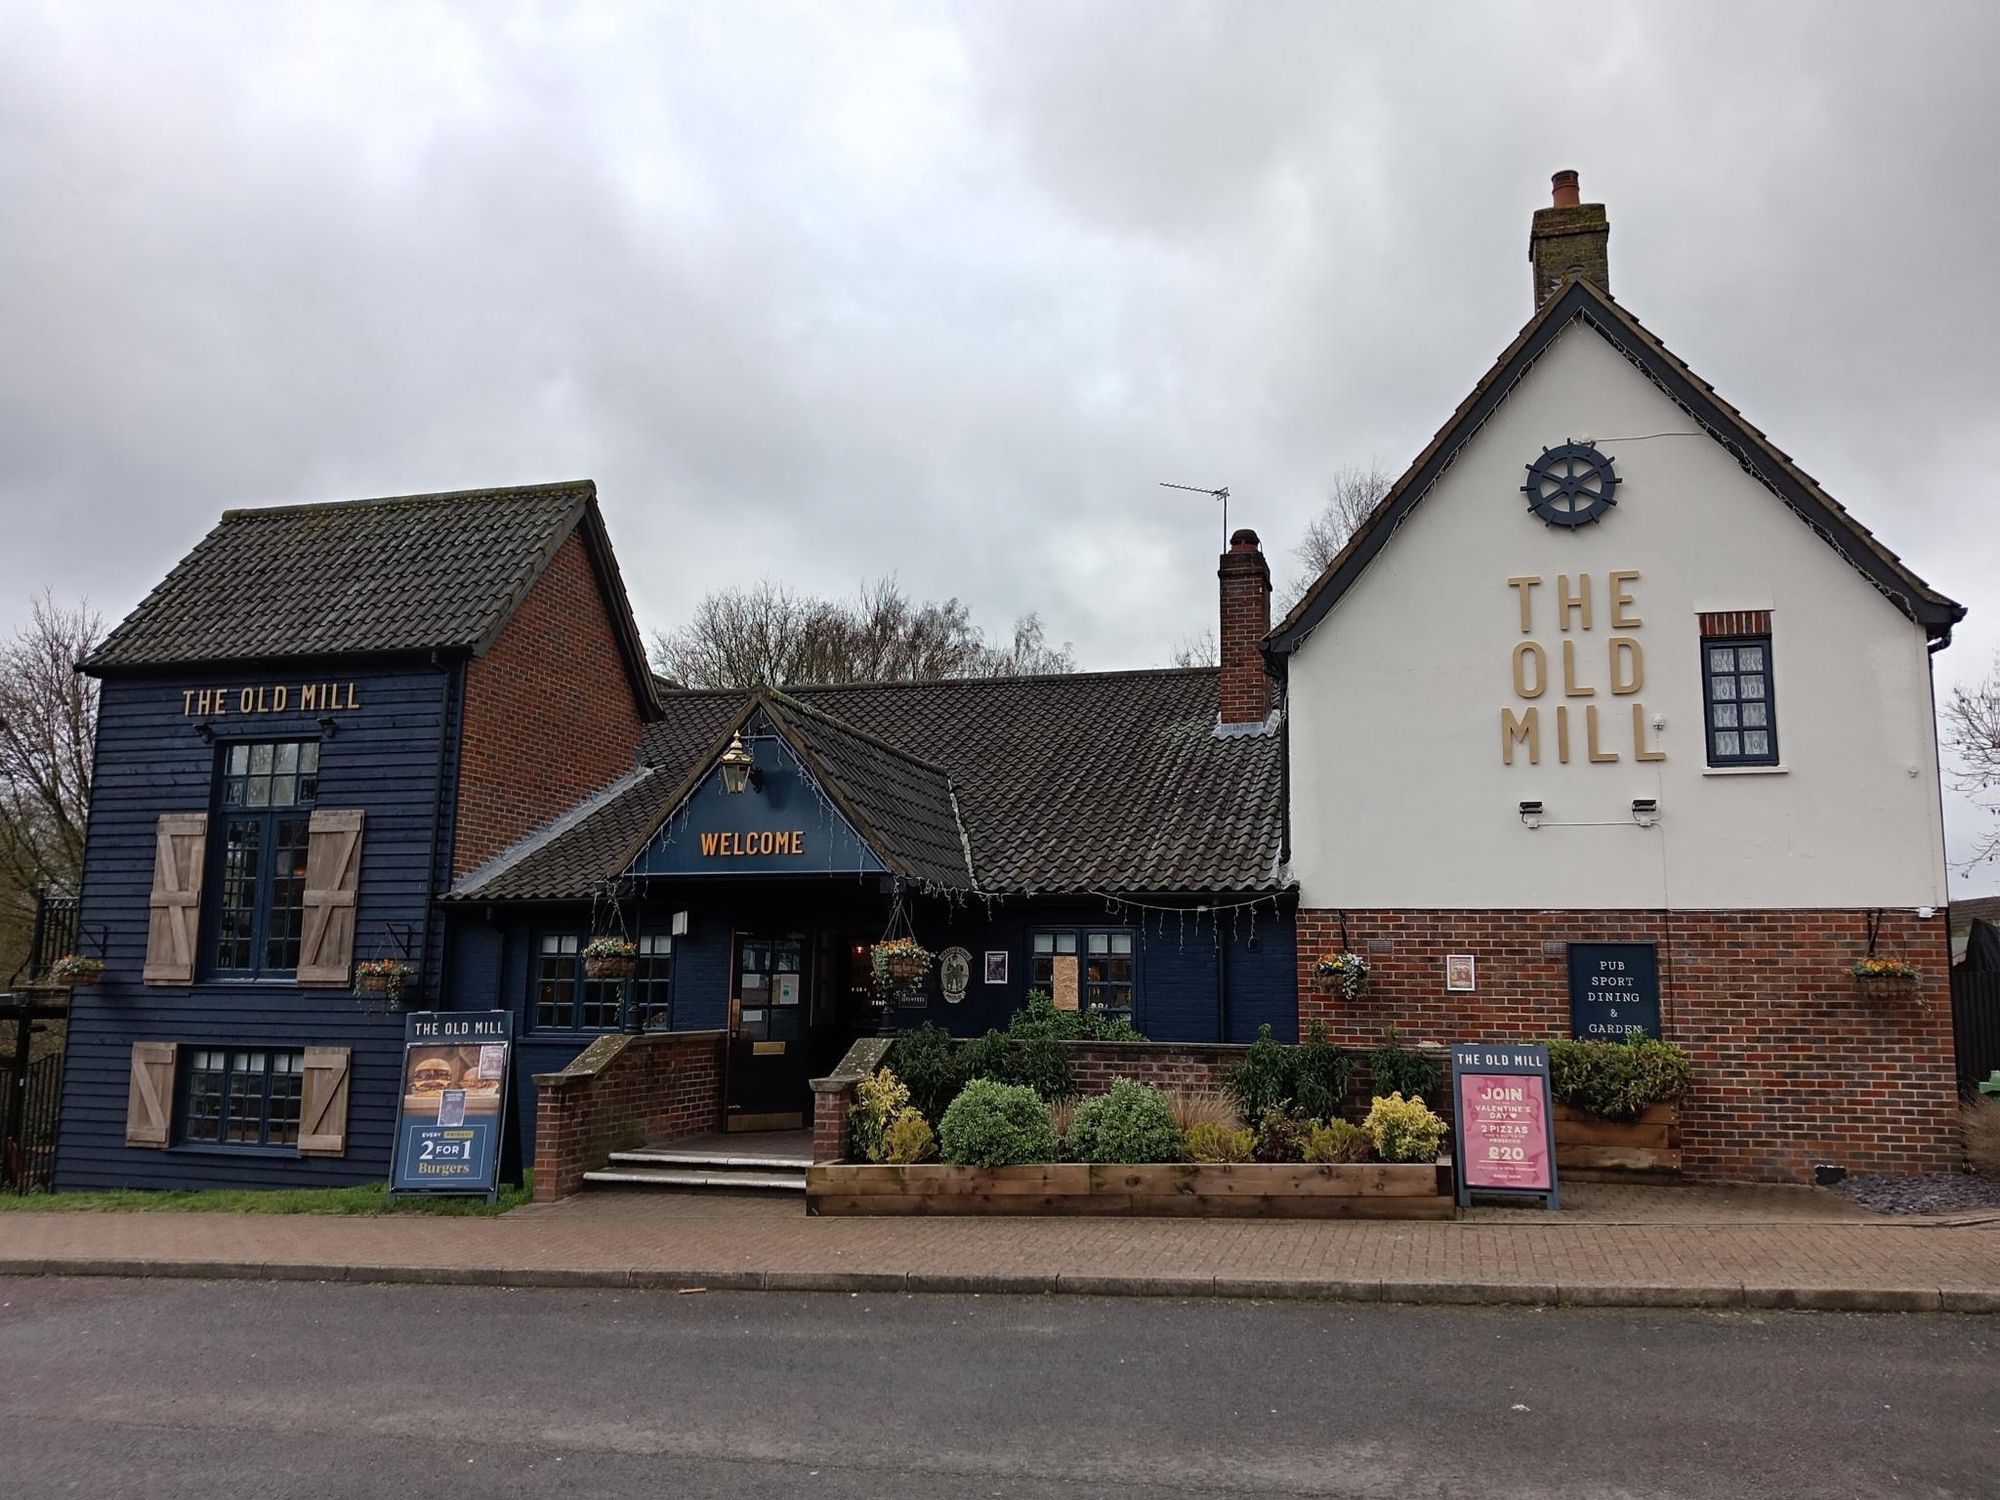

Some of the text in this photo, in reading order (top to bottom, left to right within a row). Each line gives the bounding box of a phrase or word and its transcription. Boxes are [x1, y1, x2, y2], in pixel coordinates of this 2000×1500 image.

[1507, 570, 1642, 633] THE
[1512, 637, 1644, 699] OLD
[182, 682, 361, 717] THE OLD MILL
[1500, 703, 1666, 765] MILL
[700, 830, 804, 856] WELCOME
[1599, 960, 1626, 971] PUB
[1591, 976, 1634, 987] SPORT
[1587, 992, 1640, 1003] DINING
[1610, 1008, 1618, 1018] &
[415, 1021, 504, 1036] THE OLD MILL
[1588, 1023, 1643, 1034] GARDEN
[1457, 1053, 1544, 1067] THE OLD MILL
[1481, 1087, 1523, 1101] JOIN
[1475, 1105, 1531, 1113] VALENTINE'S
[1480, 1125, 1528, 1135] 2 PIZZAS
[419, 1140, 472, 1160] 2 FOR 1
[1488, 1146, 1524, 1161] £20
[418, 1162, 470, 1176] Burgers
